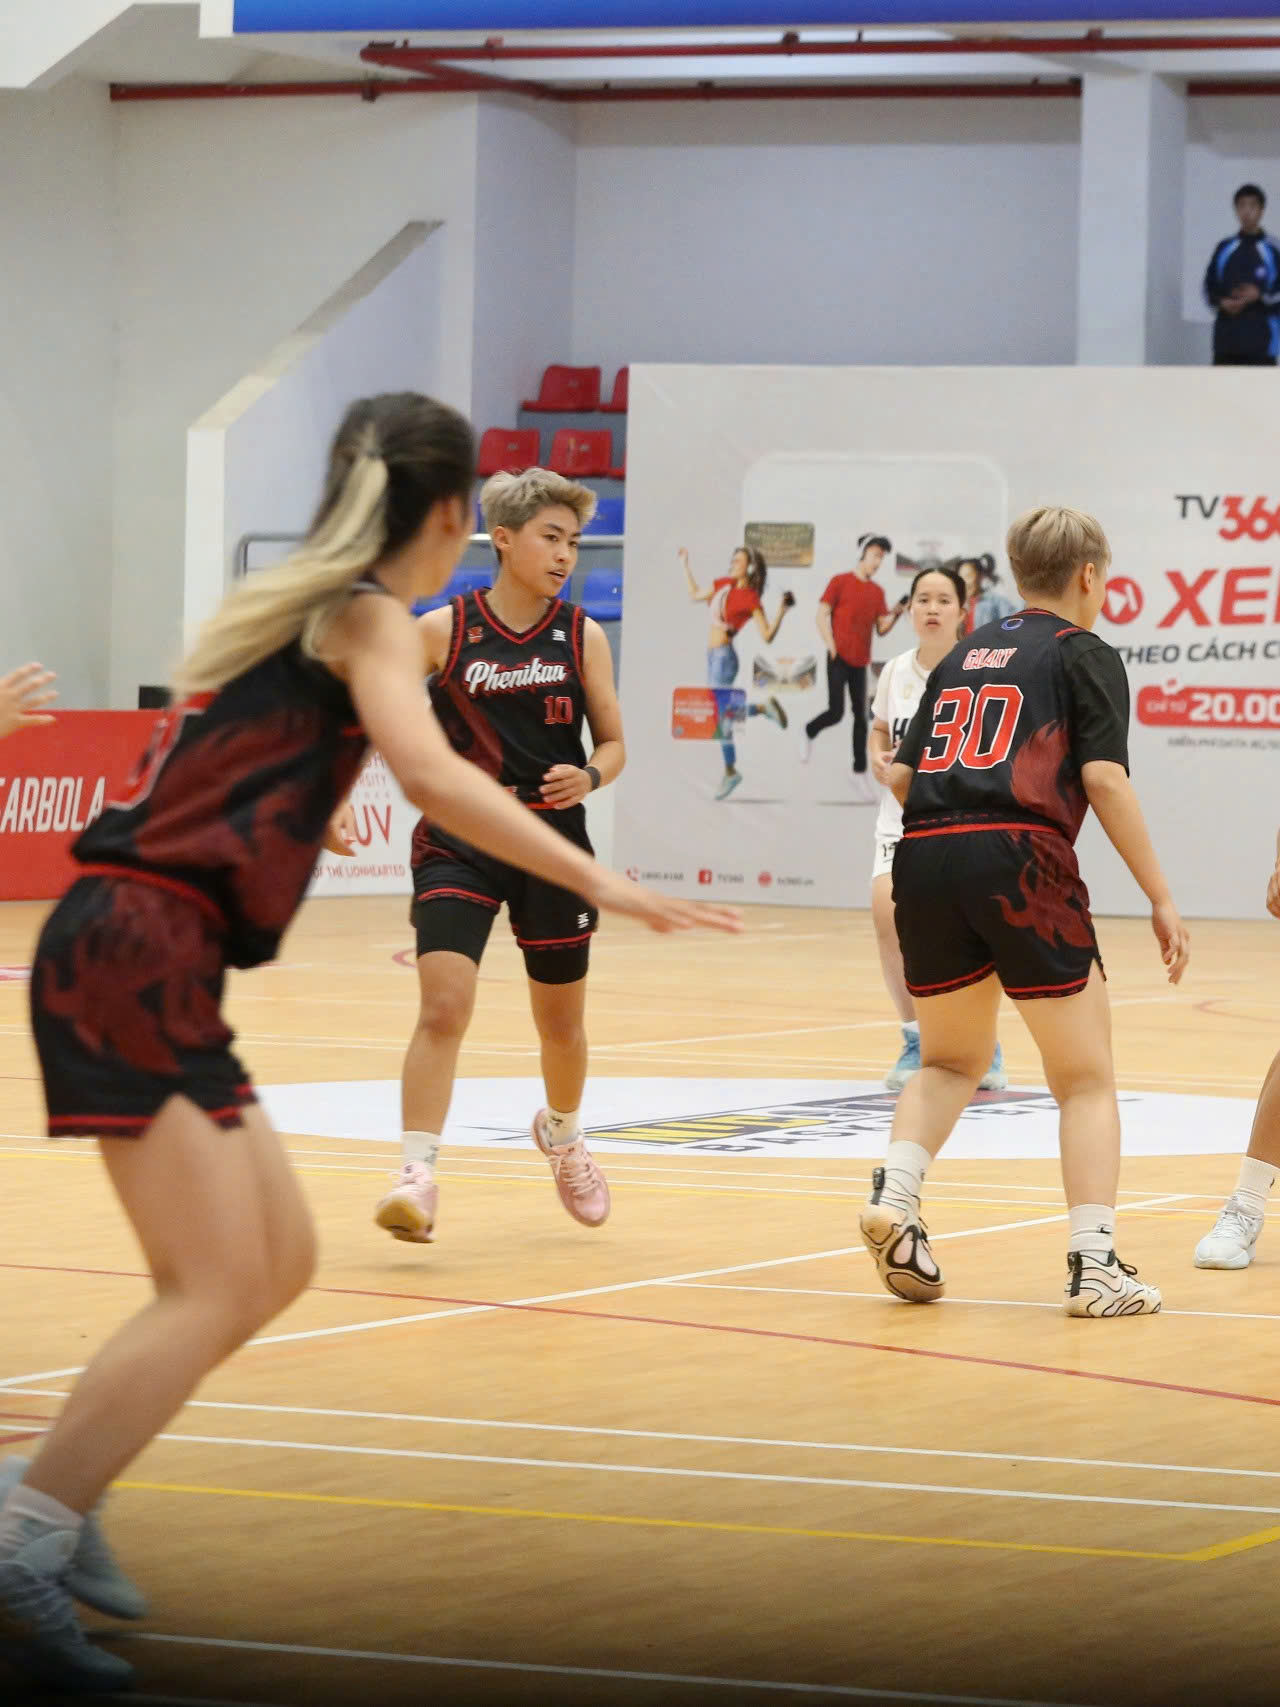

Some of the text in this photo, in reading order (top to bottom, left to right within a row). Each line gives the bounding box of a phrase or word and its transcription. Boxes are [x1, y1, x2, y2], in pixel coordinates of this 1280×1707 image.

[963, 648, 1018, 670] GALAXY
[1187, 636, 1257, 661] CÁCH
[465, 657, 568, 694] Phenikaa
[544, 695, 573, 725] 10
[918, 684, 1024, 773] 30
[0, 775, 106, 833] ARBOLA
[344, 804, 391, 847] UV
